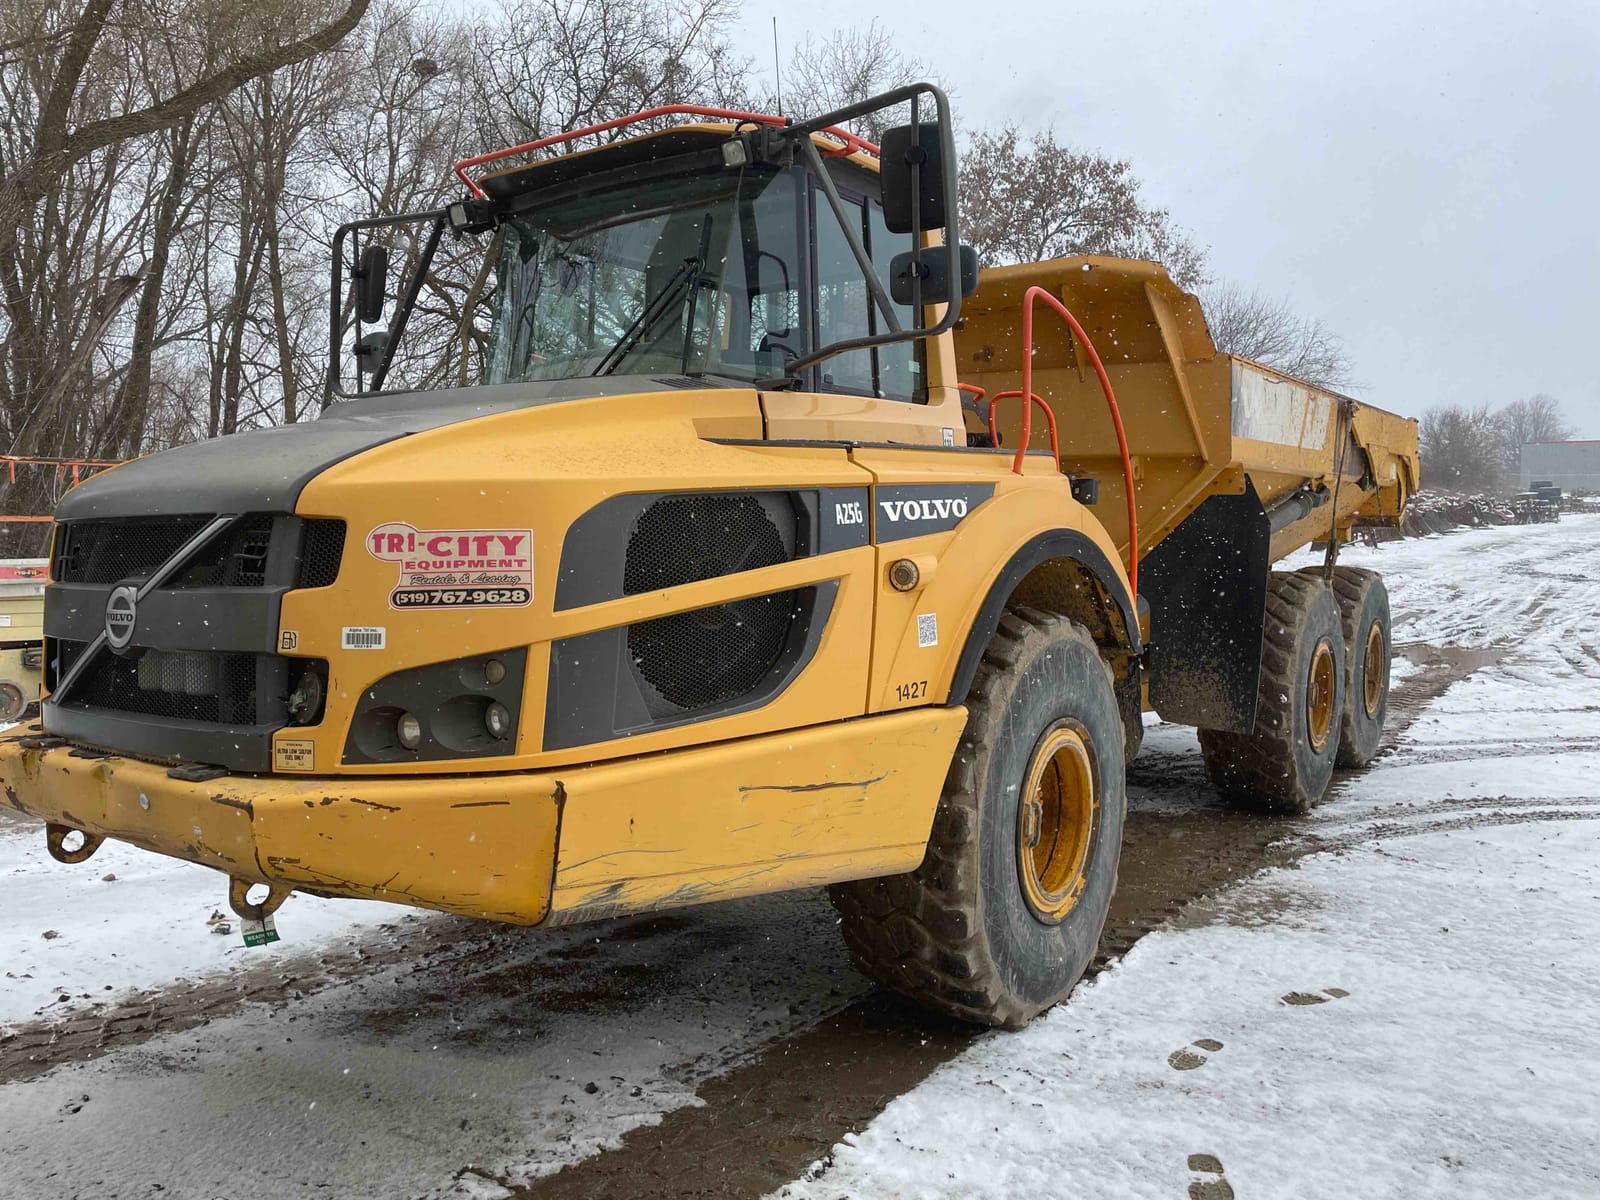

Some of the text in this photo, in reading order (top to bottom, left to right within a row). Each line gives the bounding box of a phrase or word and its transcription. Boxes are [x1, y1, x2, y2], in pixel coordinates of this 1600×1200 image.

[835, 501, 863, 525] A25G
[880, 499, 967, 522] VOLVO
[372, 533, 525, 557] TRI-CITY
[405, 559, 528, 571] EQUIPMENT
[410, 573, 521, 586] Rentals & Leasing
[396, 589, 526, 604] (519) 767-9628
[896, 681, 928, 702] 1427
